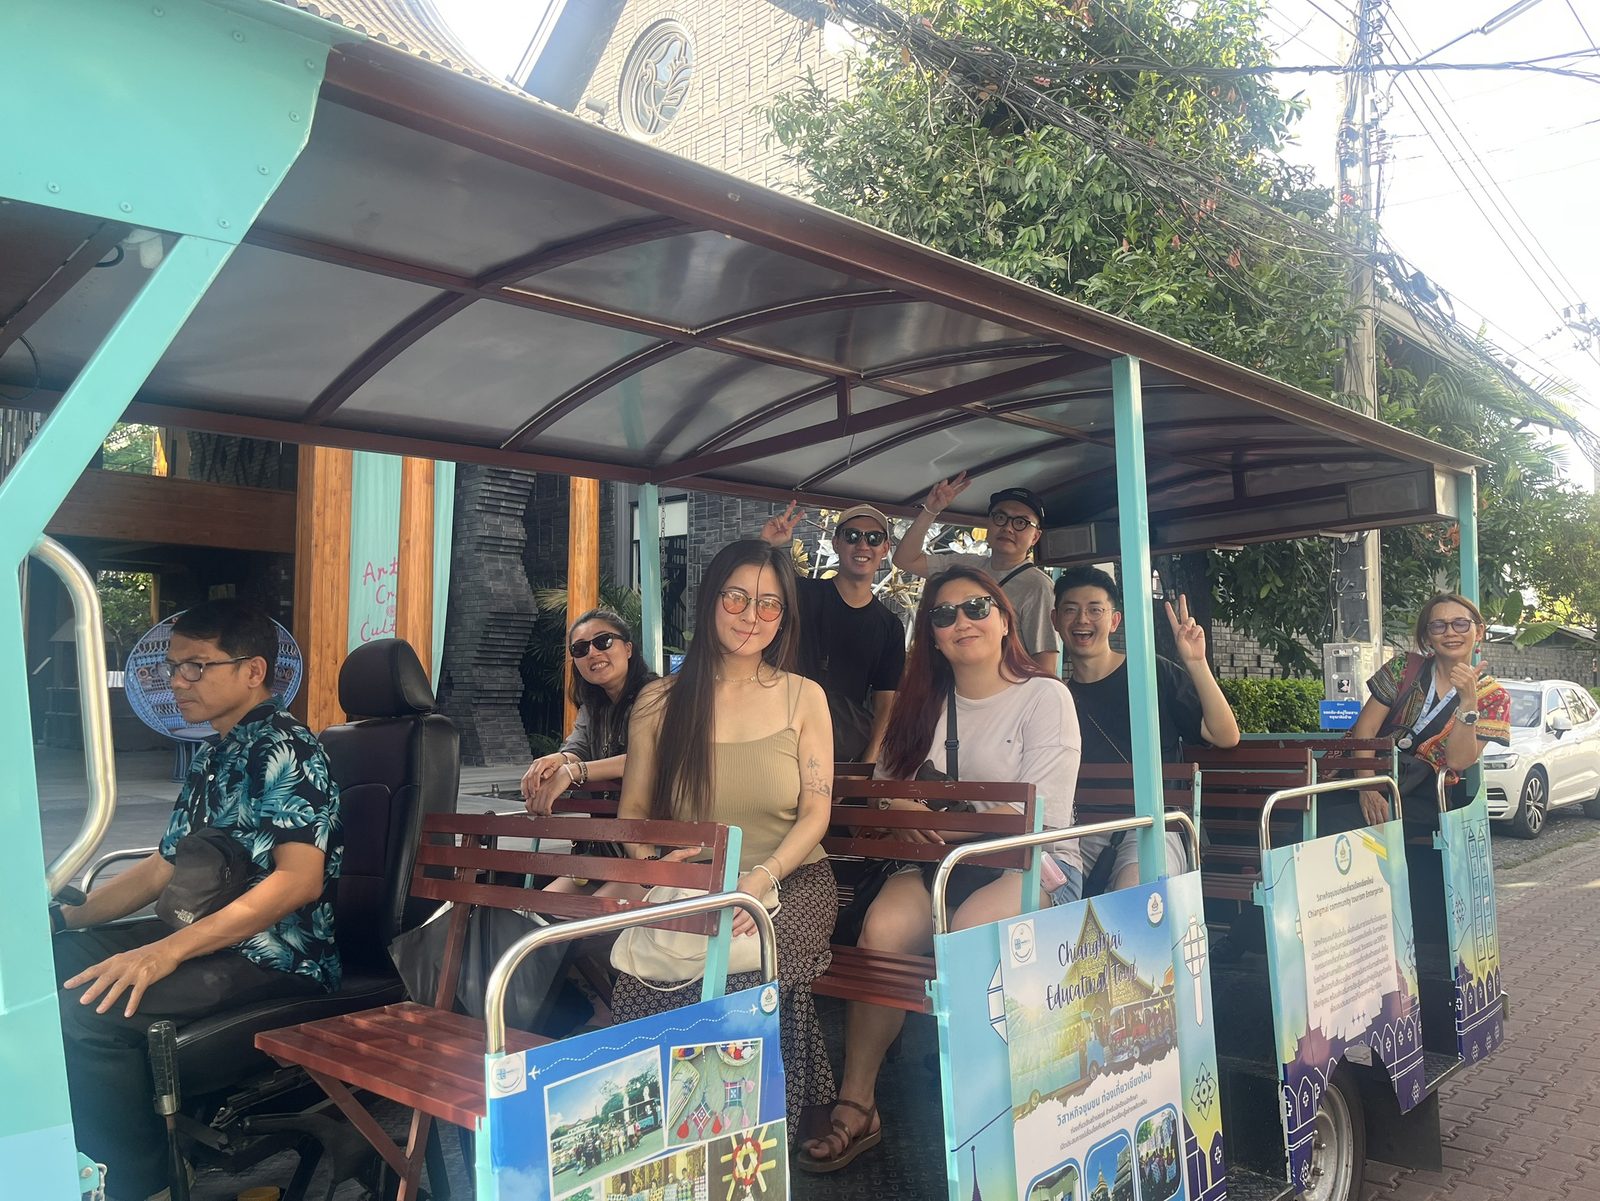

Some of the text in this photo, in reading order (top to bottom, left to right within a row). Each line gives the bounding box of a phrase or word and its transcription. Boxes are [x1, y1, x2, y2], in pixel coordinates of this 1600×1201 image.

[363, 556, 398, 586] Art
[376, 584, 396, 604] Cr
[1329, 898, 1352, 912] community
[1351, 892, 1366, 903] tourism
[1056, 1097, 1100, 1127] วิสาหกิจชุมชน
